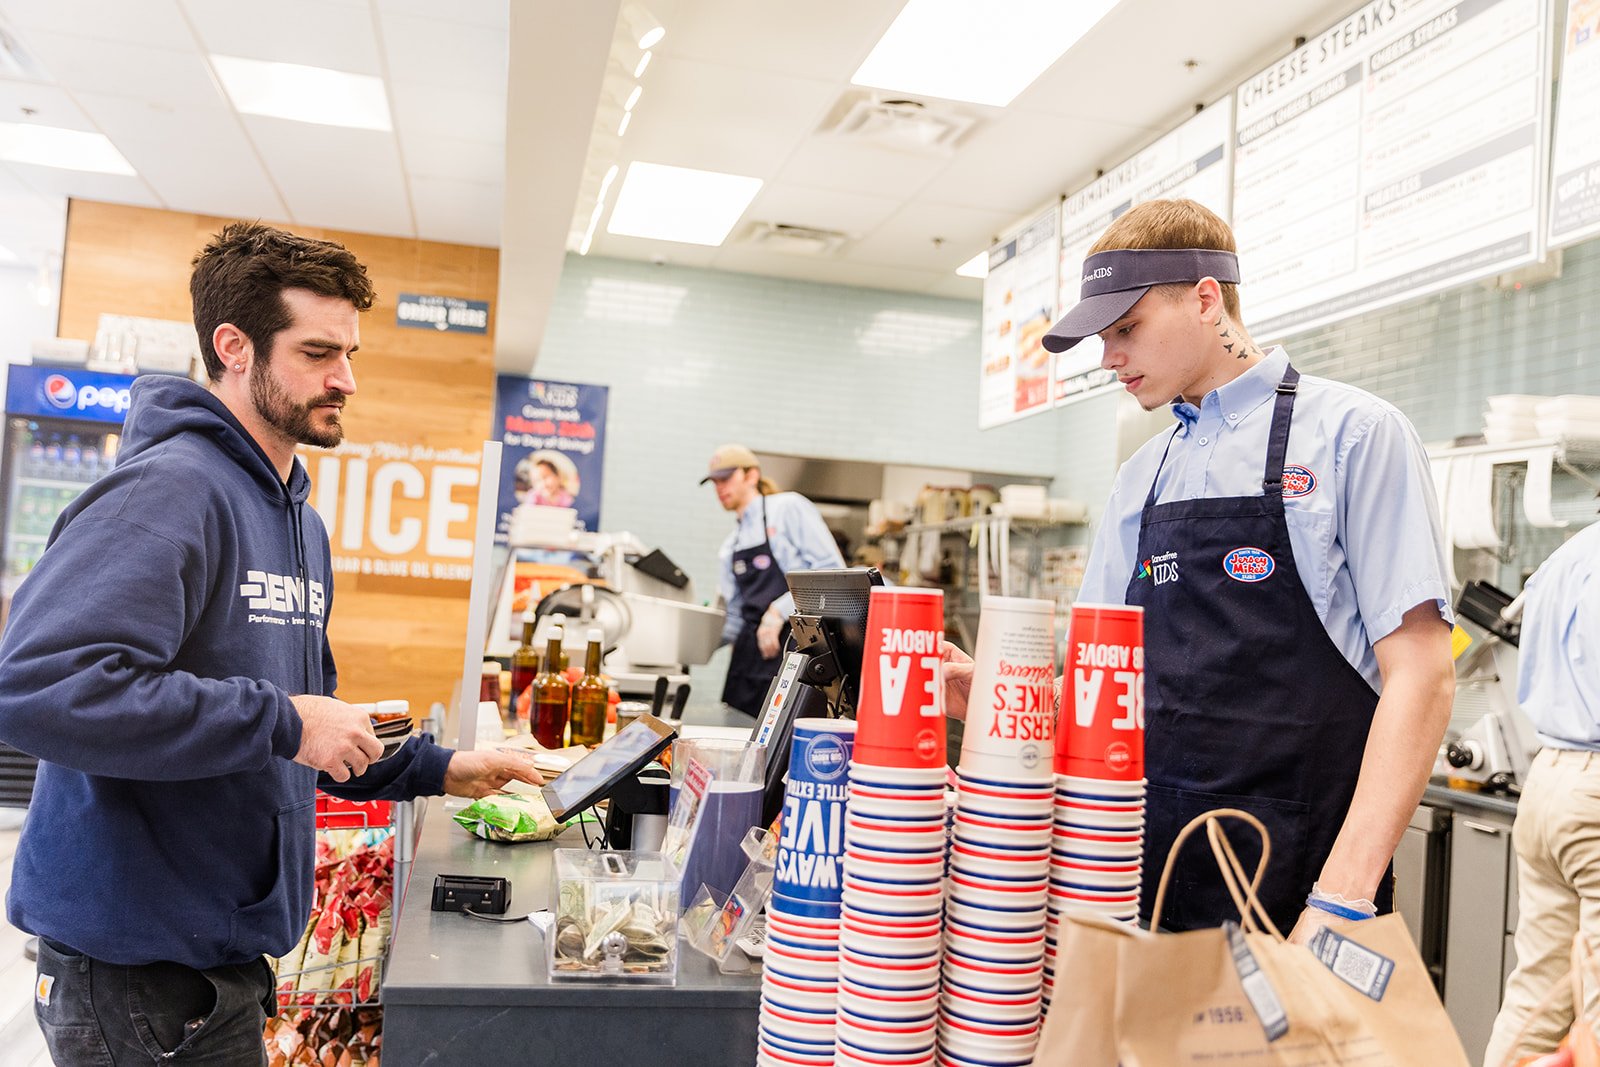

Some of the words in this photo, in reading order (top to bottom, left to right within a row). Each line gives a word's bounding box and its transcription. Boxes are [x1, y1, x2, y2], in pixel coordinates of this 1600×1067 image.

[1242, 49, 1309, 108] CHEESE
[1319, 0, 1396, 64] STEAKS
[398, 302, 447, 323] ORDER
[448, 308, 487, 328] HERE
[297, 454, 480, 559] UICE
[1152, 561, 1179, 586] KIDS
[1230, 554, 1268, 566] Jersey
[1232, 563, 1266, 574] Mike's
[880, 627, 935, 654] ABOVE
[1077, 641, 1132, 669] ABOVE
[996, 658, 1054, 683] Believes
[878, 653, 912, 717] A
[1073, 668, 1104, 729] A
